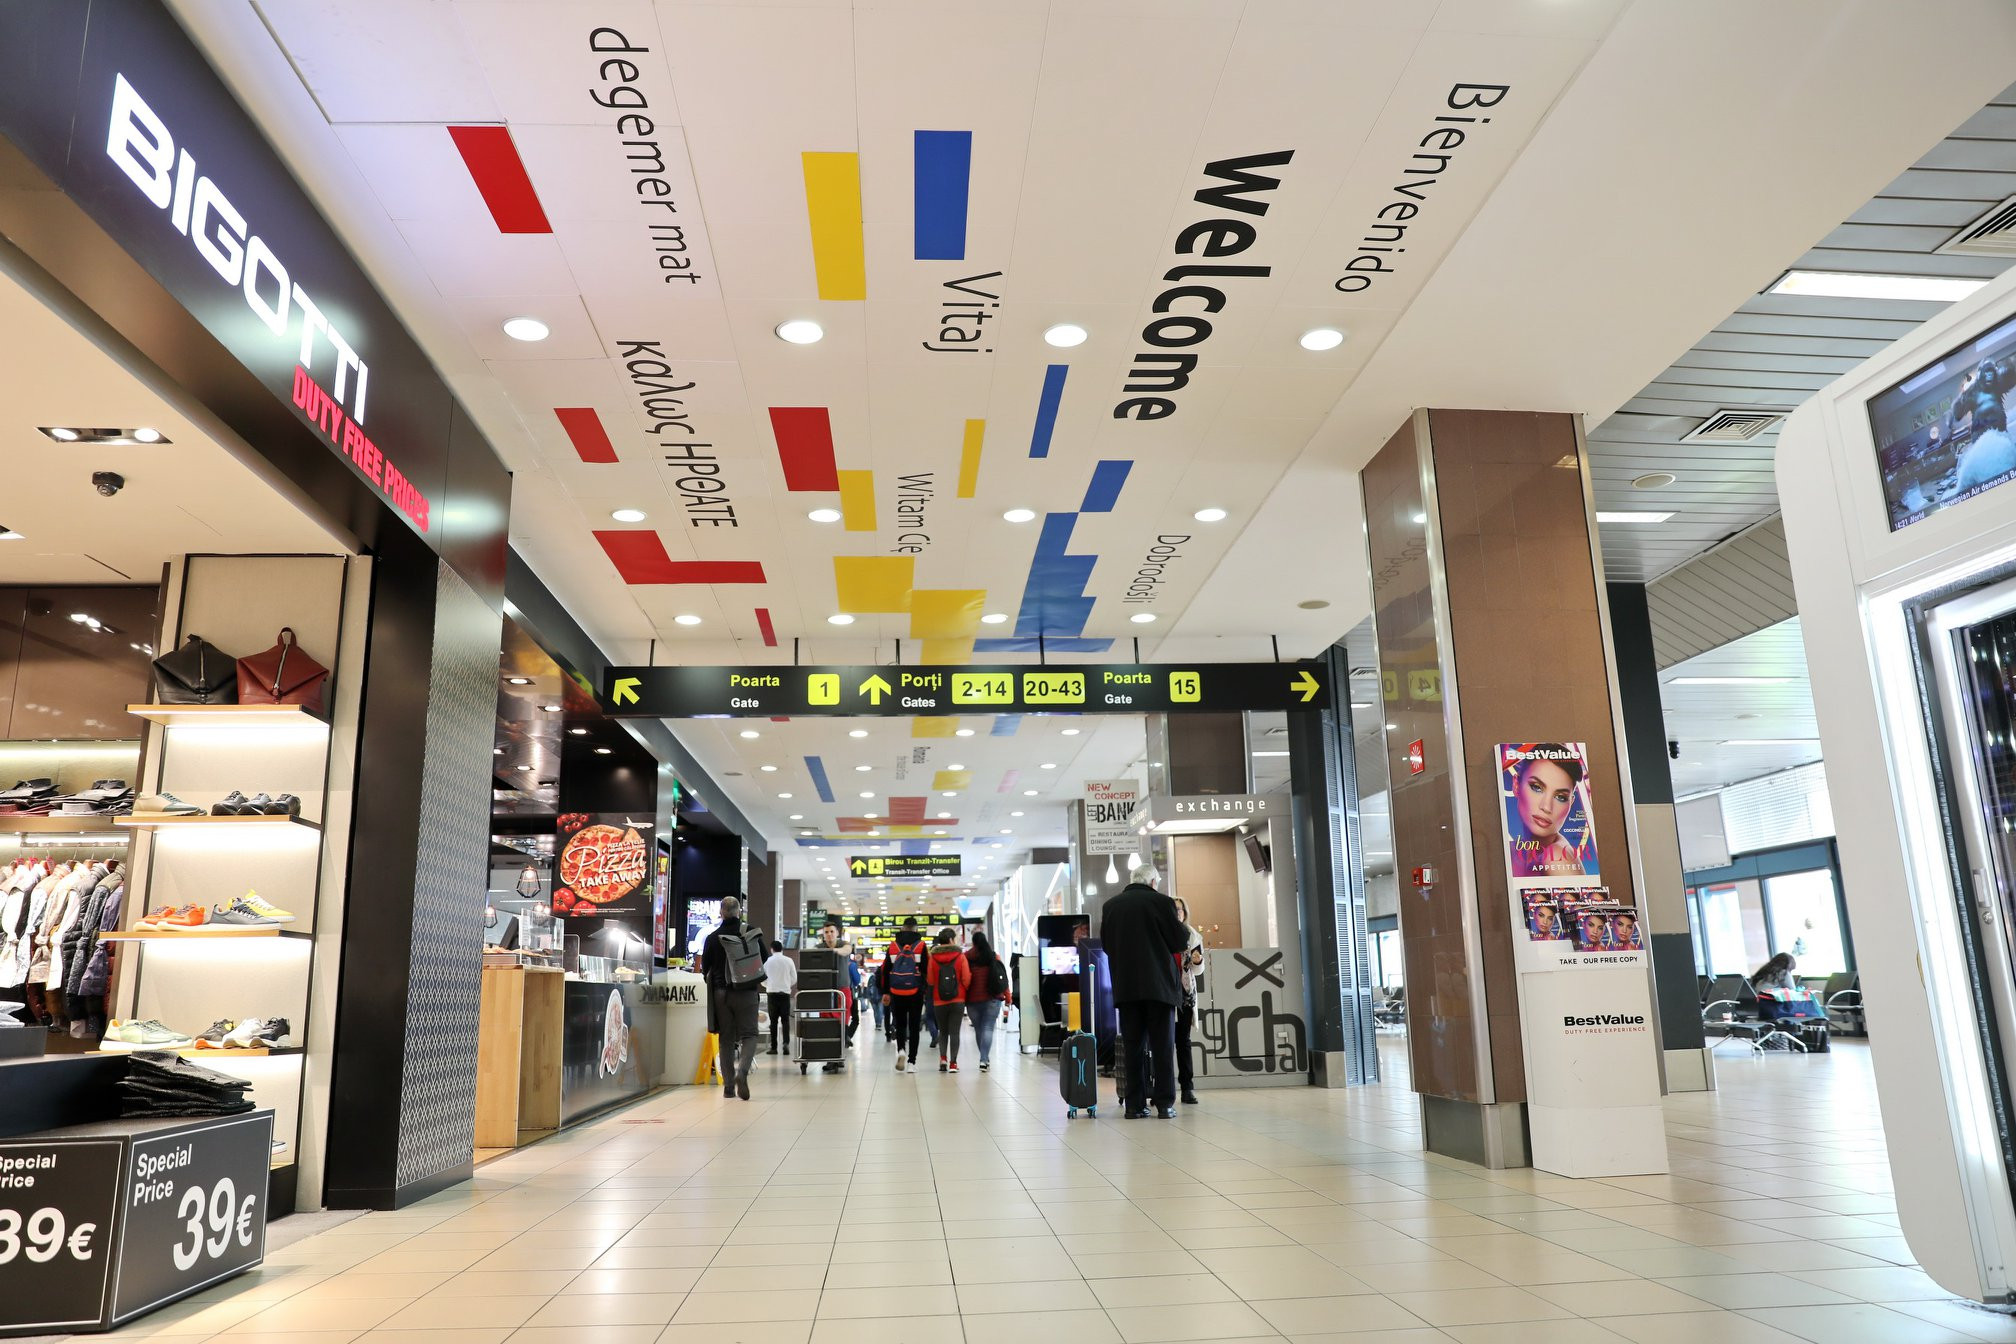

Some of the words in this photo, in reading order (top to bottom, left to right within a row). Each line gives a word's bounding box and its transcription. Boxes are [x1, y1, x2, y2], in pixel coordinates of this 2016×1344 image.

[589, 27, 677, 214] degemer
[649, 225, 702, 284] mat
[1335, 83, 1510, 292] Bienvenido
[106, 72, 368, 425] BIGOTTI
[1113, 150, 1295, 421] Welcome
[923, 271, 1003, 353] Vitaj
[292, 364, 344, 444] DUTY
[342, 416, 384, 487] FREE
[383, 459, 430, 533] PRICES
[897, 473, 934, 527] Witam
[1940, 492, 1971, 510] Norwegian
[1971, 487, 1980, 495] Air
[1981, 474, 2009, 492] demands
[890, 533, 931, 553] Cię
[1122, 535, 1191, 603] Dobrodošli
[730, 674, 780, 687] Poarta
[820, 681, 829, 698] 1
[901, 673, 942, 692] Porți
[961, 680, 1007, 697] 2-14
[1025, 680, 1083, 697] 20-43
[1104, 672, 1152, 684] Poarta
[1174, 679, 1196, 695] 15
[730, 698, 759, 708] Gate
[902, 697, 936, 709] Gates
[1104, 693, 1132, 705] Gate
[1506, 749, 1581, 760] BestValue
[1088, 783, 1111, 792] NEW
[1094, 792, 1135, 800] CONCEPT
[1096, 801, 1135, 823] BANK
[1176, 799, 1266, 812] exchange
[1515, 835, 1540, 851] bon
[560, 846, 647, 885] Pizza
[1532, 864, 1581, 872] APPETITE!
[580, 875, 609, 888] TAKE
[612, 869, 647, 883] AWAY
[1564, 1014, 1644, 1026] BestValue
[136, 1144, 193, 1179] Special
[0, 1174, 35, 1188] rice
[133, 1179, 174, 1207] Price
[173, 1177, 257, 1271] 39€
